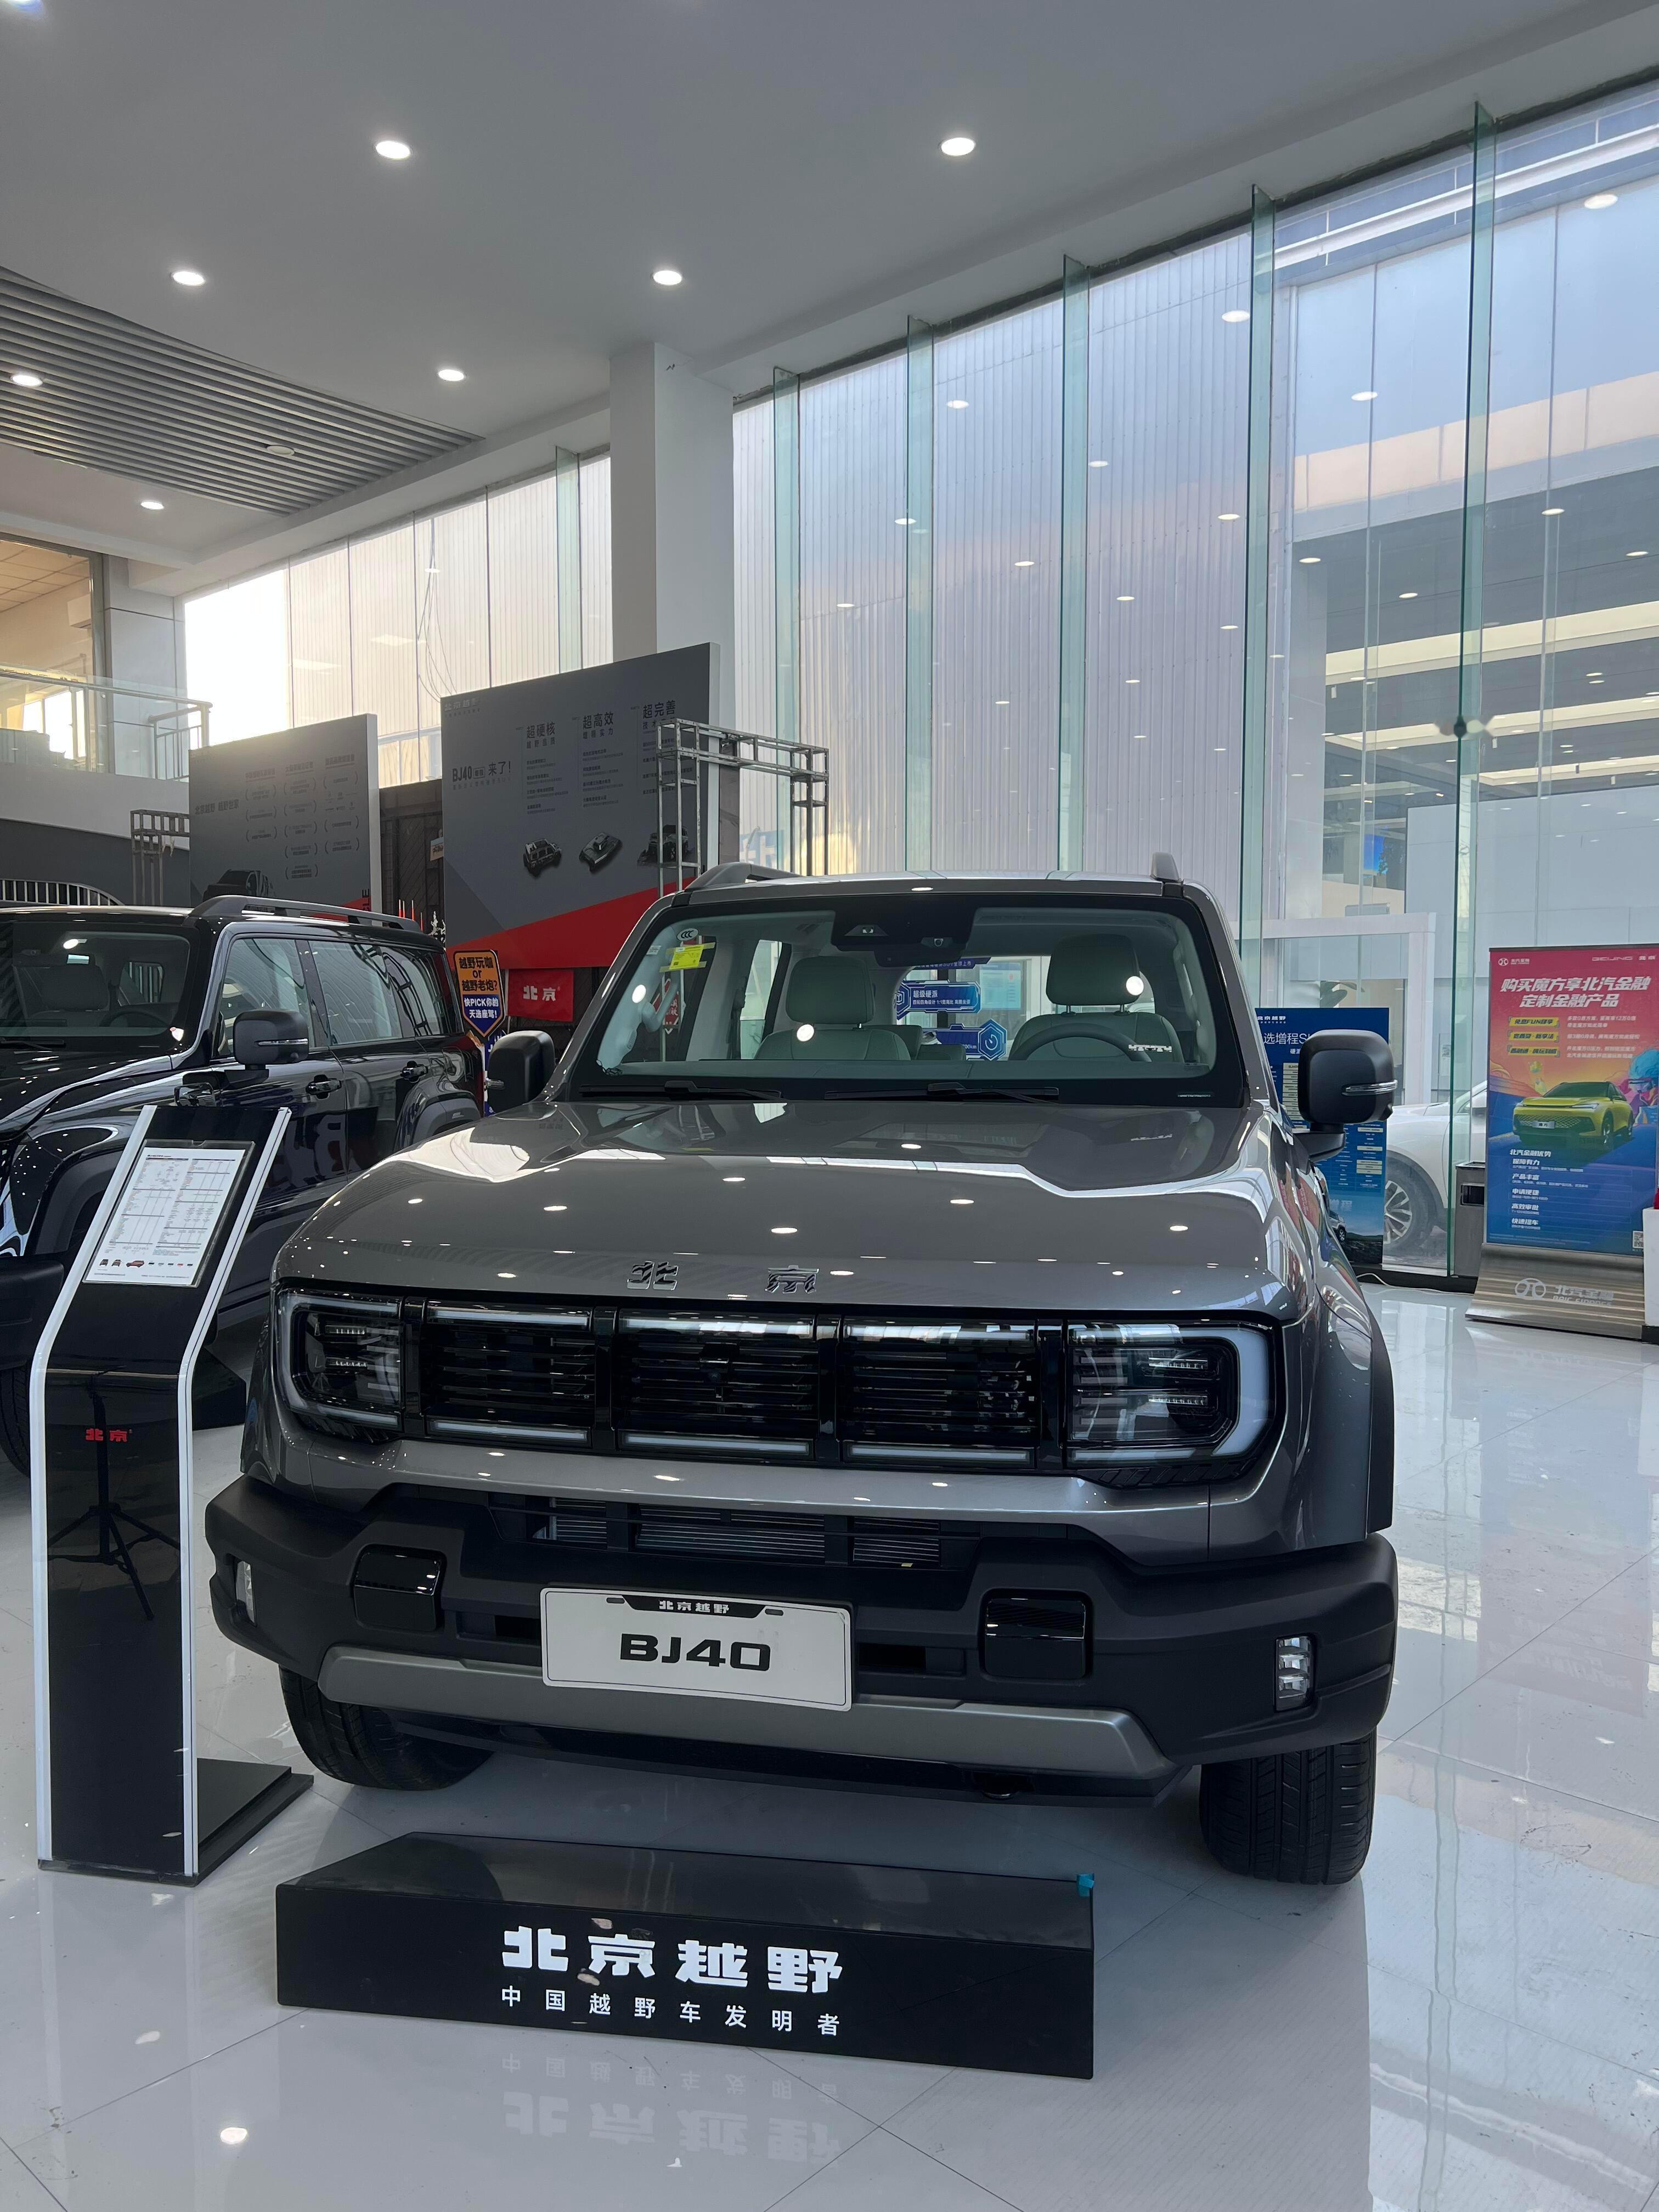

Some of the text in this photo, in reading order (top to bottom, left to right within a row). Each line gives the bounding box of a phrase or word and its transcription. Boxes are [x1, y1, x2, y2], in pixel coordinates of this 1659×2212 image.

[642, 700, 676, 720] 超完善
[583, 712, 614, 730] 超高效
[526, 721, 556, 739] 超硬核
[452, 766, 472, 782] BJ40
[459, 957, 494, 969] 越野玩咖
[472, 969, 482, 978] or
[1499, 976, 1651, 992] 购买魔方享北汽金融
[523, 985, 556, 1001] 北京
[913, 990, 938, 998] 超级硬派
[1519, 994, 1620, 1007] 定制金融产品
[464, 997, 499, 1007] 快PICK你的
[1512, 1158, 1540, 1166] 保障有力
[1554, 1284, 1614, 1301] 北汽金融
[85, 1428, 127, 1442] 北京
[659, 1599, 730, 1615] 北京越野
[619, 1633, 771, 1672] BJ40
[501, 1926, 843, 1994] 北京越野
[501, 1985, 840, 2036] 中国越野车发明者
